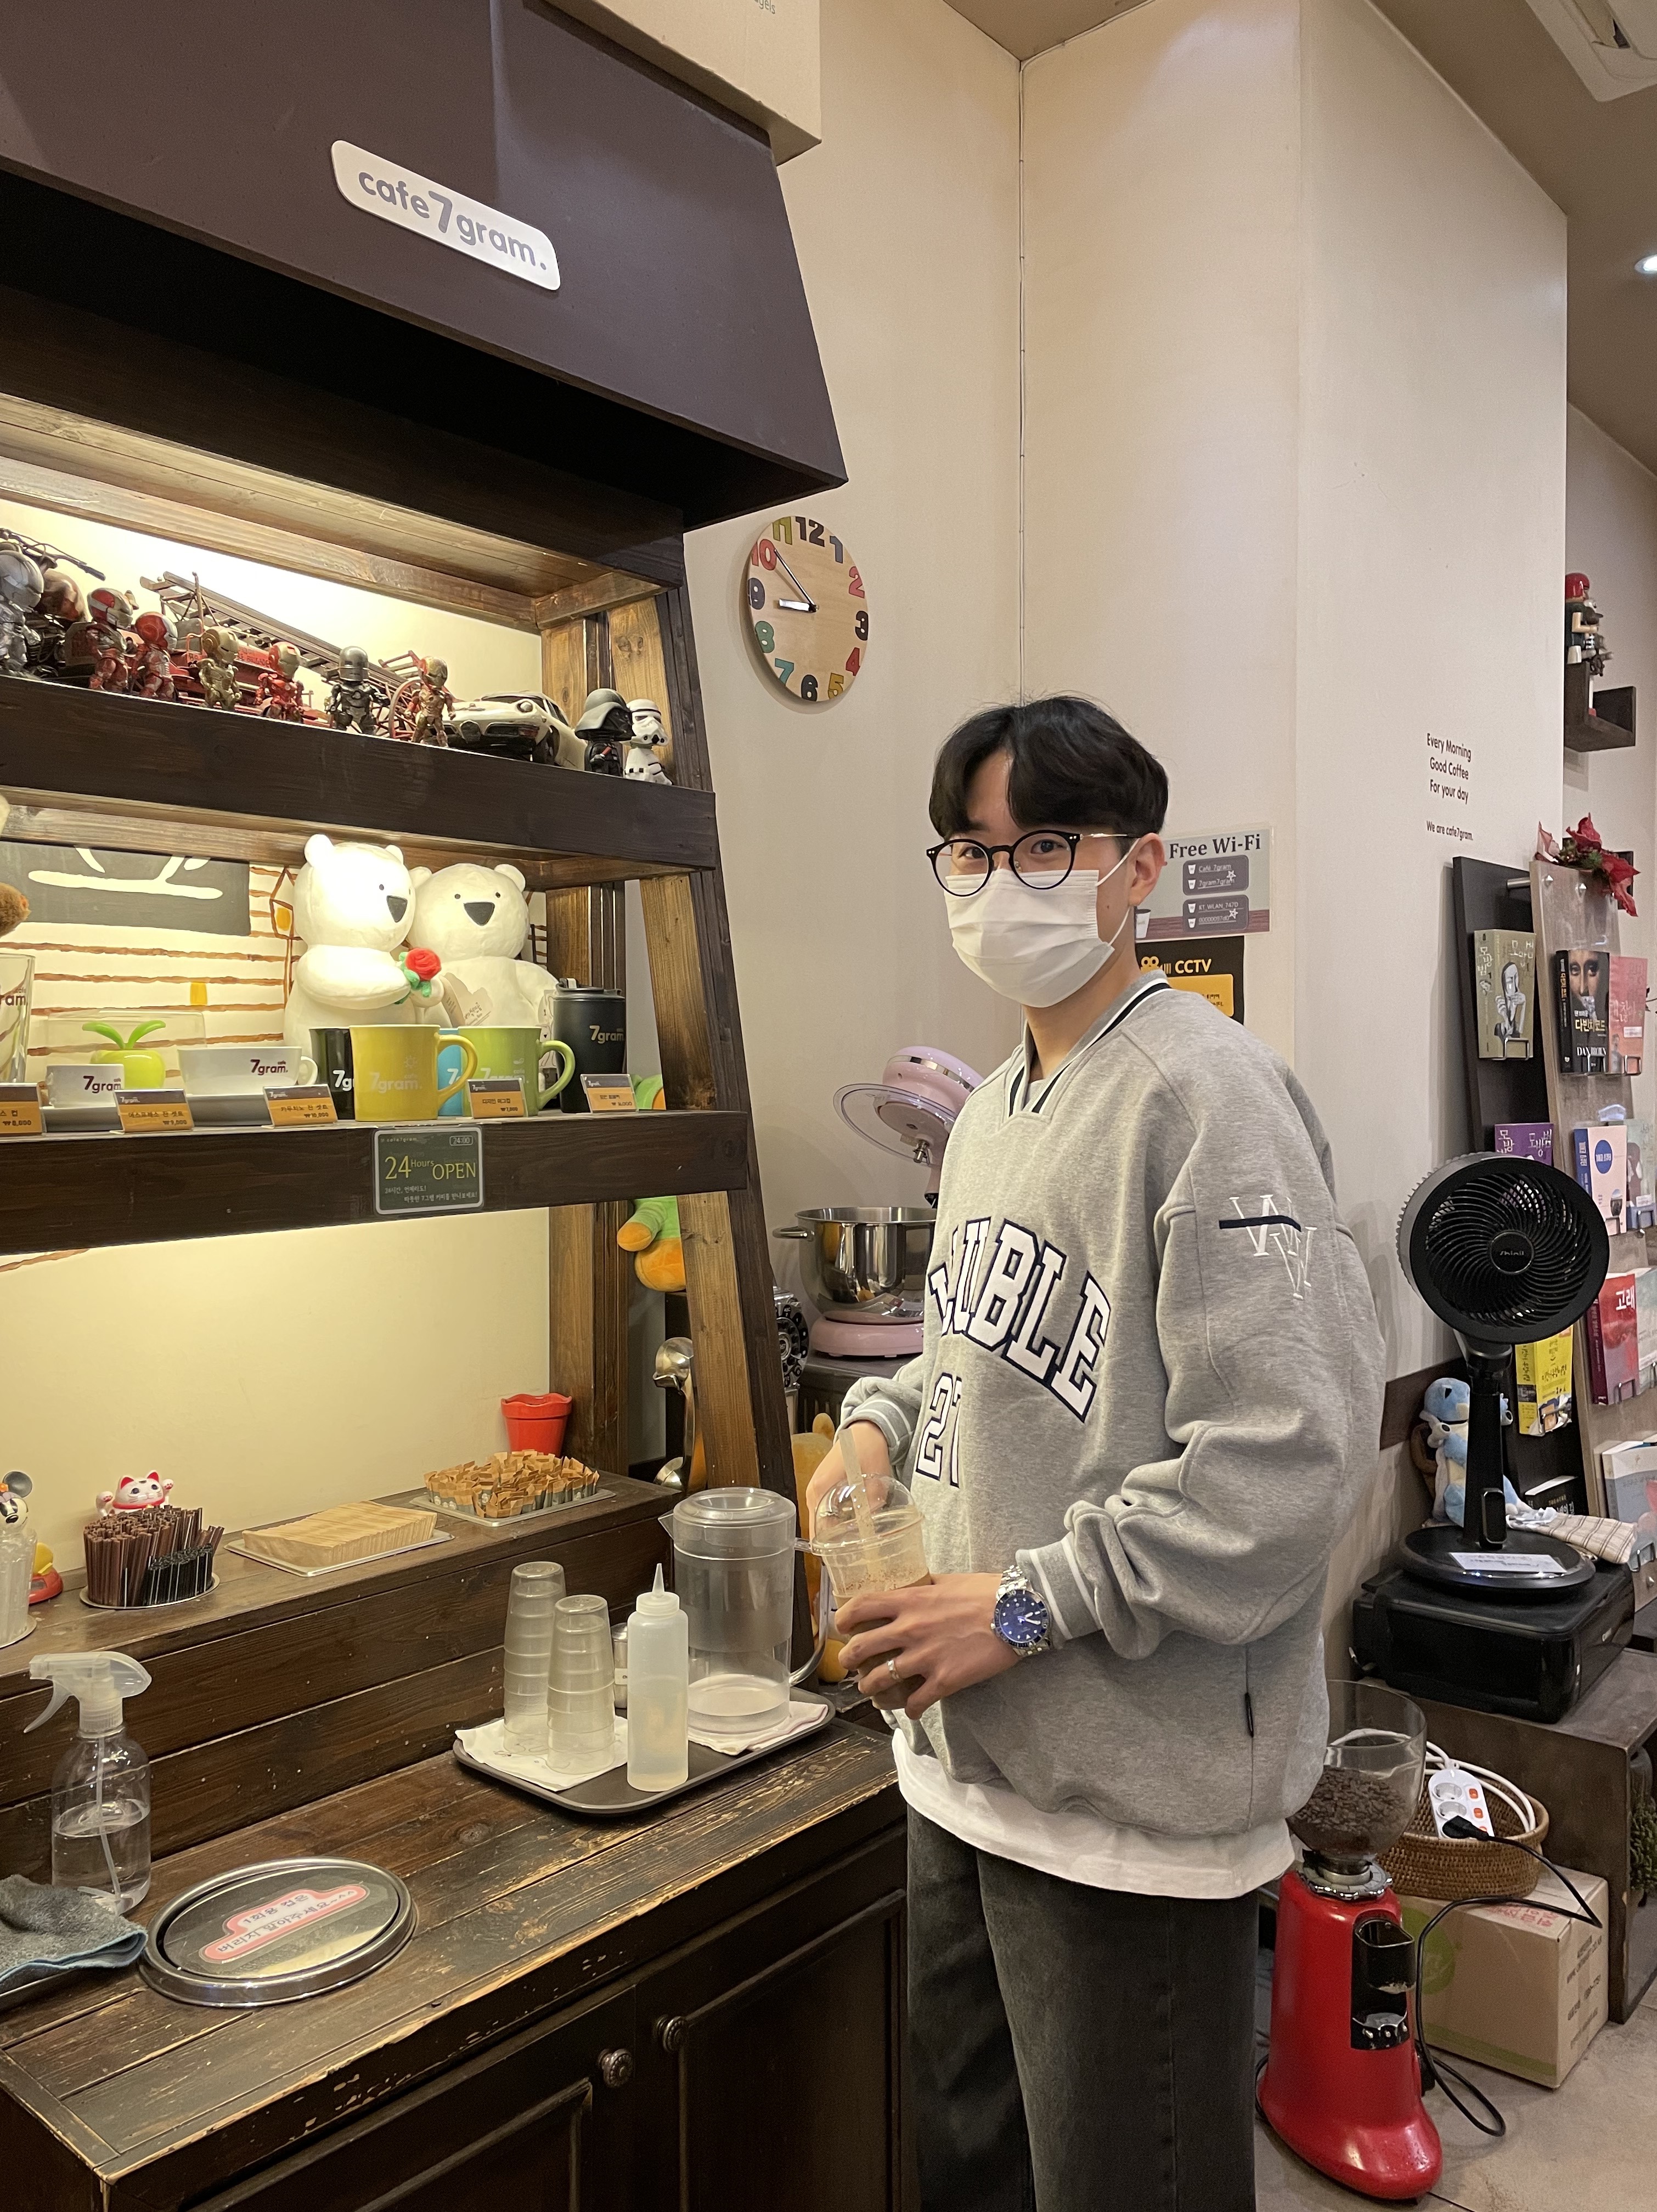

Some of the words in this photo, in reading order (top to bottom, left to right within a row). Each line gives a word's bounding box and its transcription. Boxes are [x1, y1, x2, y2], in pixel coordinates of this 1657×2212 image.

[772, 516, 792, 545] 11
[796, 516, 825, 547] 12
[751, 539, 777, 571] 10
[830, 535, 843, 564] 1
[748, 578, 765, 610] 9
[849, 566, 865, 599] 2
[755, 621, 775, 653] 8
[855, 611, 869, 641] 3
[775, 658, 794, 685] 7
[846, 647, 860, 676] 4
[801, 674, 818, 702] 6
[827, 673, 844, 699] 5
[1427, 733, 1444, 753] Every
[1446, 739, 1472, 763] Morning
[1430, 757, 1447, 774] Good
[1449, 762, 1468, 780] Coffee
[1430, 779, 1440, 793] For
[1442, 785, 1456, 799] your
[1457, 786, 1468, 805] day
[1426, 821, 1435, 833] We
[1436, 824, 1445, 834] are
[1169, 843, 1207, 859] Free
[1212, 833, 1261, 855] Wi-Fi
[1175, 958, 1212, 974] CCTV
[1575, 1018, 1606, 1032] 다빈치코드
[369, 1072, 422, 1093] 7gram.
[385, 1155, 412, 1180] 24
[412, 1159, 435, 1168] Hours
[432, 1163, 476, 1180] OPEN
[1615, 1285, 1636, 1311] 고래
[243, 1907, 278, 1923] 1회용
[280, 1894, 309, 1907] 컵은
[217, 1929, 261, 1952] 버리지
